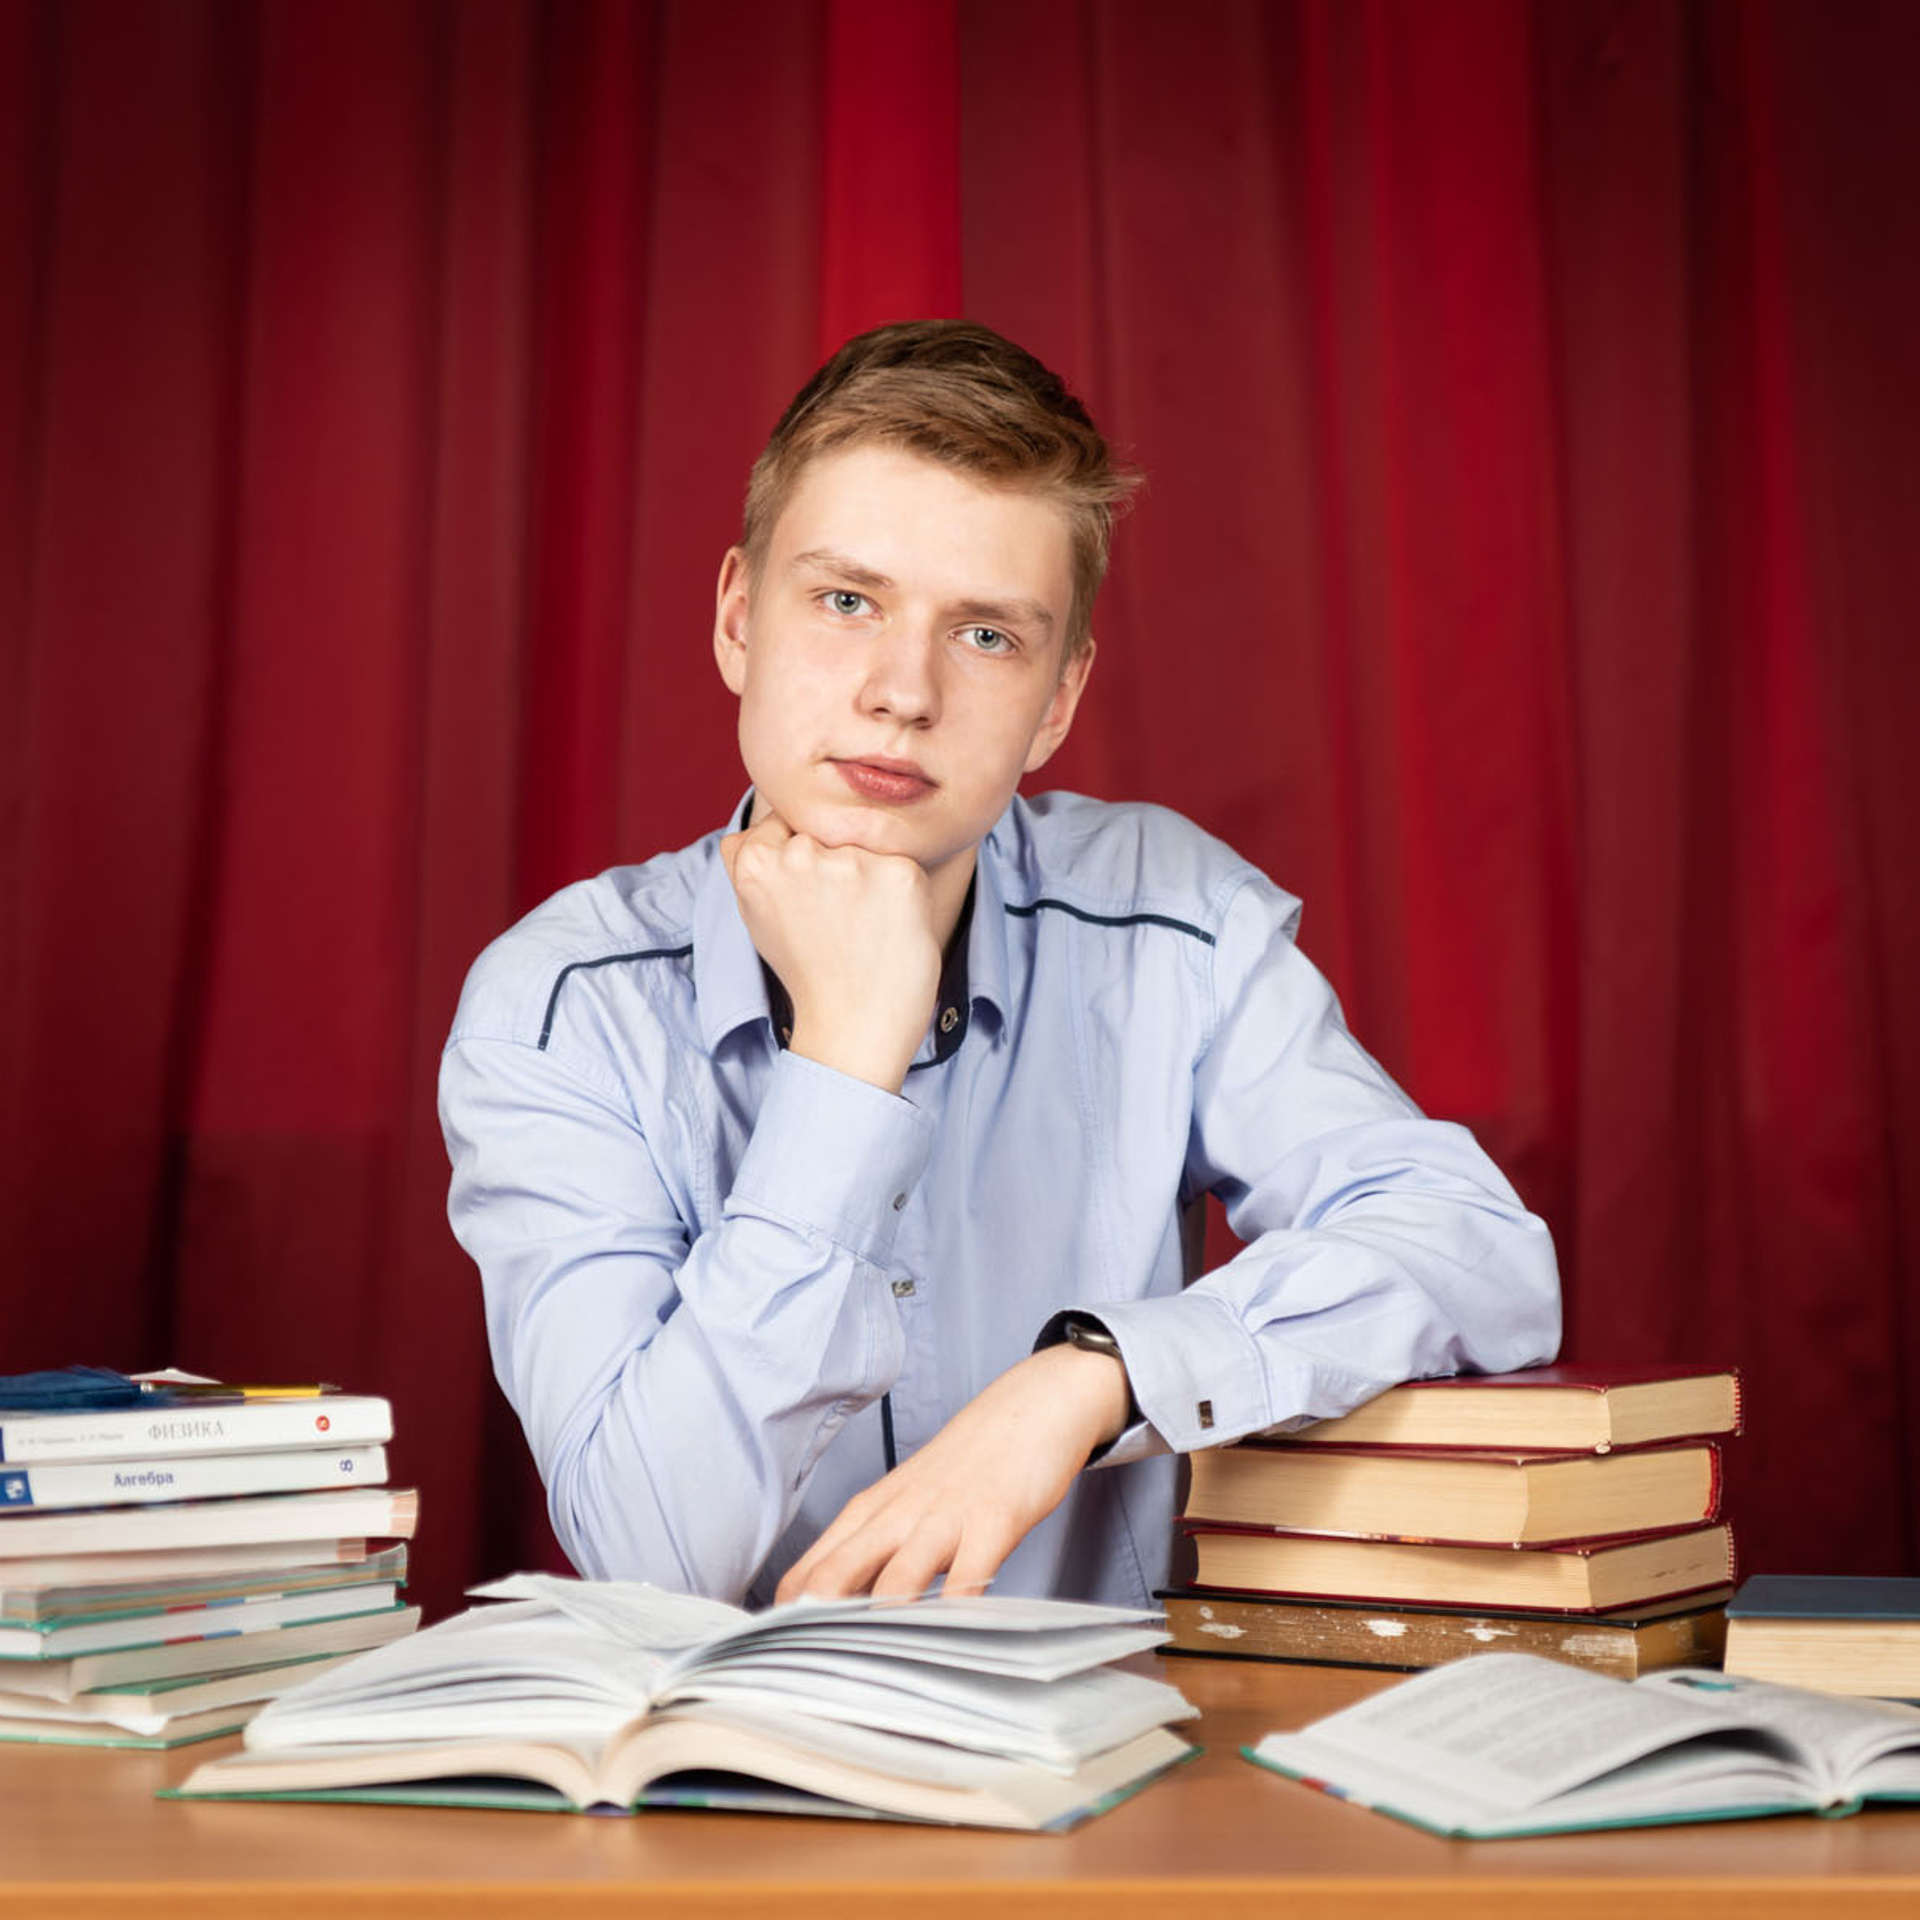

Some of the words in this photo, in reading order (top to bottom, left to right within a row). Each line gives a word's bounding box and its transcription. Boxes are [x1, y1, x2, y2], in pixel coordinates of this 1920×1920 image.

[148, 1420, 224, 1440] ФИЗИКА
[339, 1458, 354, 1472] 8
[114, 1471, 174, 1488] Алгебра
